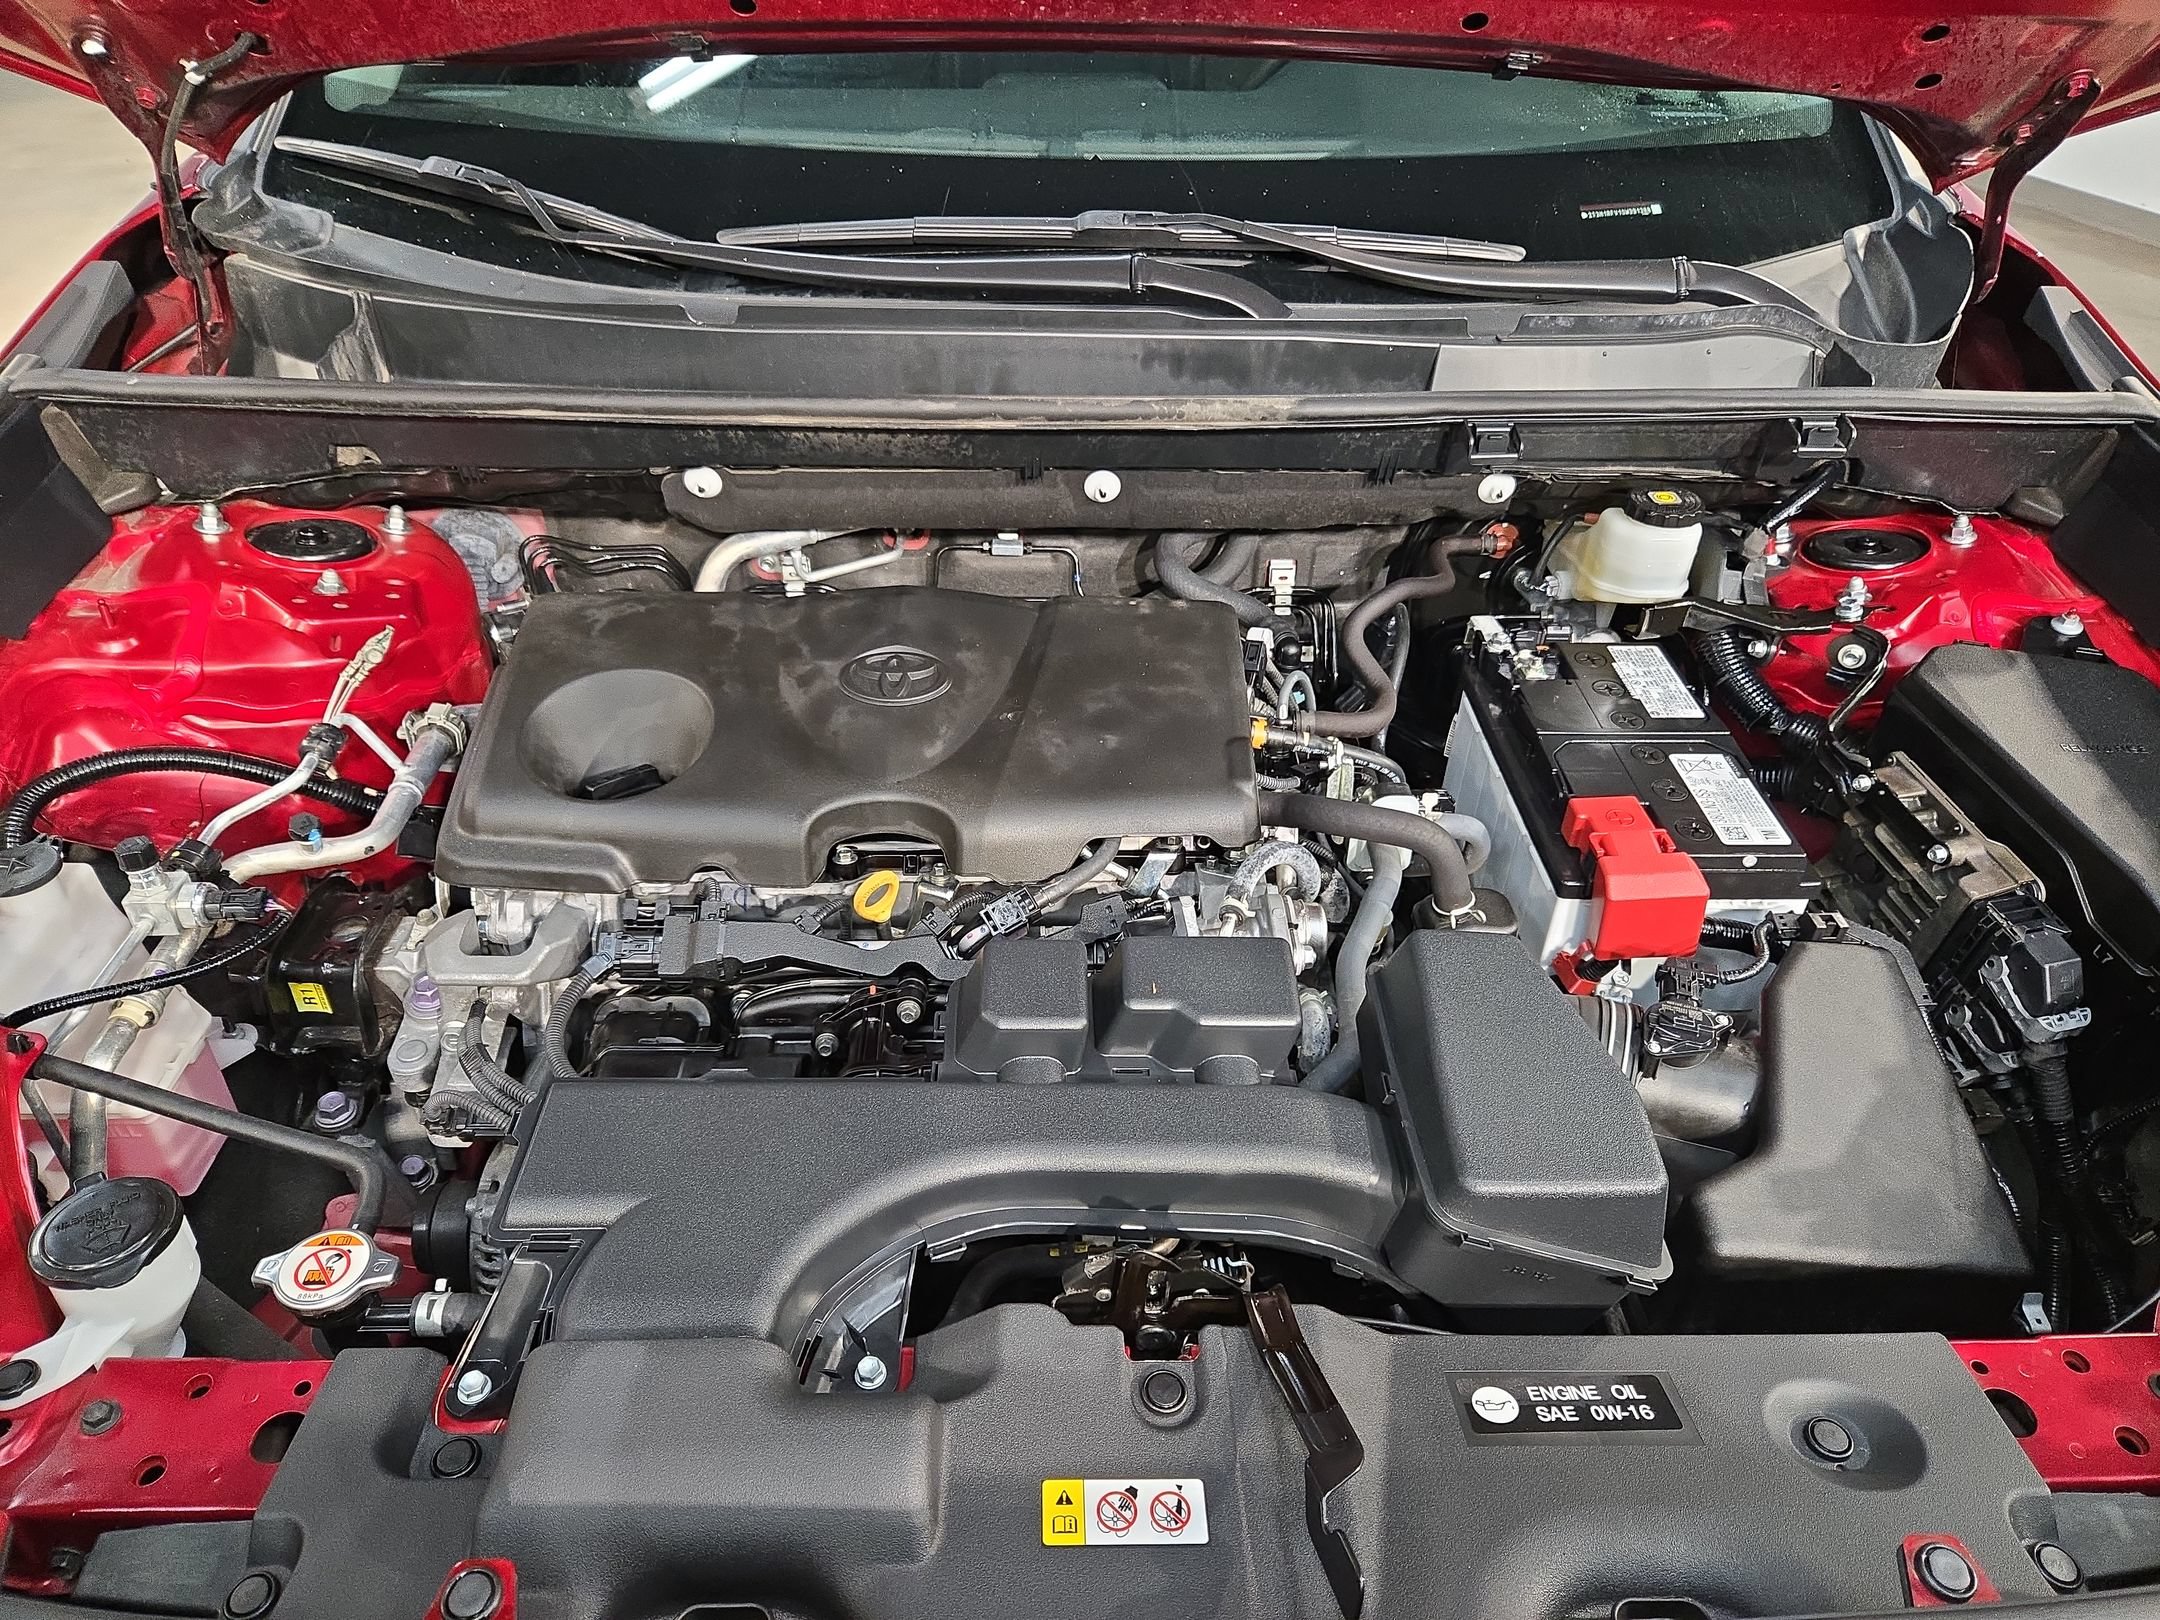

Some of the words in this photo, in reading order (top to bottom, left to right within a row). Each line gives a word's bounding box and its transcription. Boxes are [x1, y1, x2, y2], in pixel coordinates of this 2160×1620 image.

[300, 989, 318, 1005] R1
[1526, 1385, 1601, 1401] ENGINE
[1610, 1384, 1646, 1400] OIL
[1535, 1406, 1580, 1422] SAE
[1590, 1404, 1655, 1421] 0W-16
